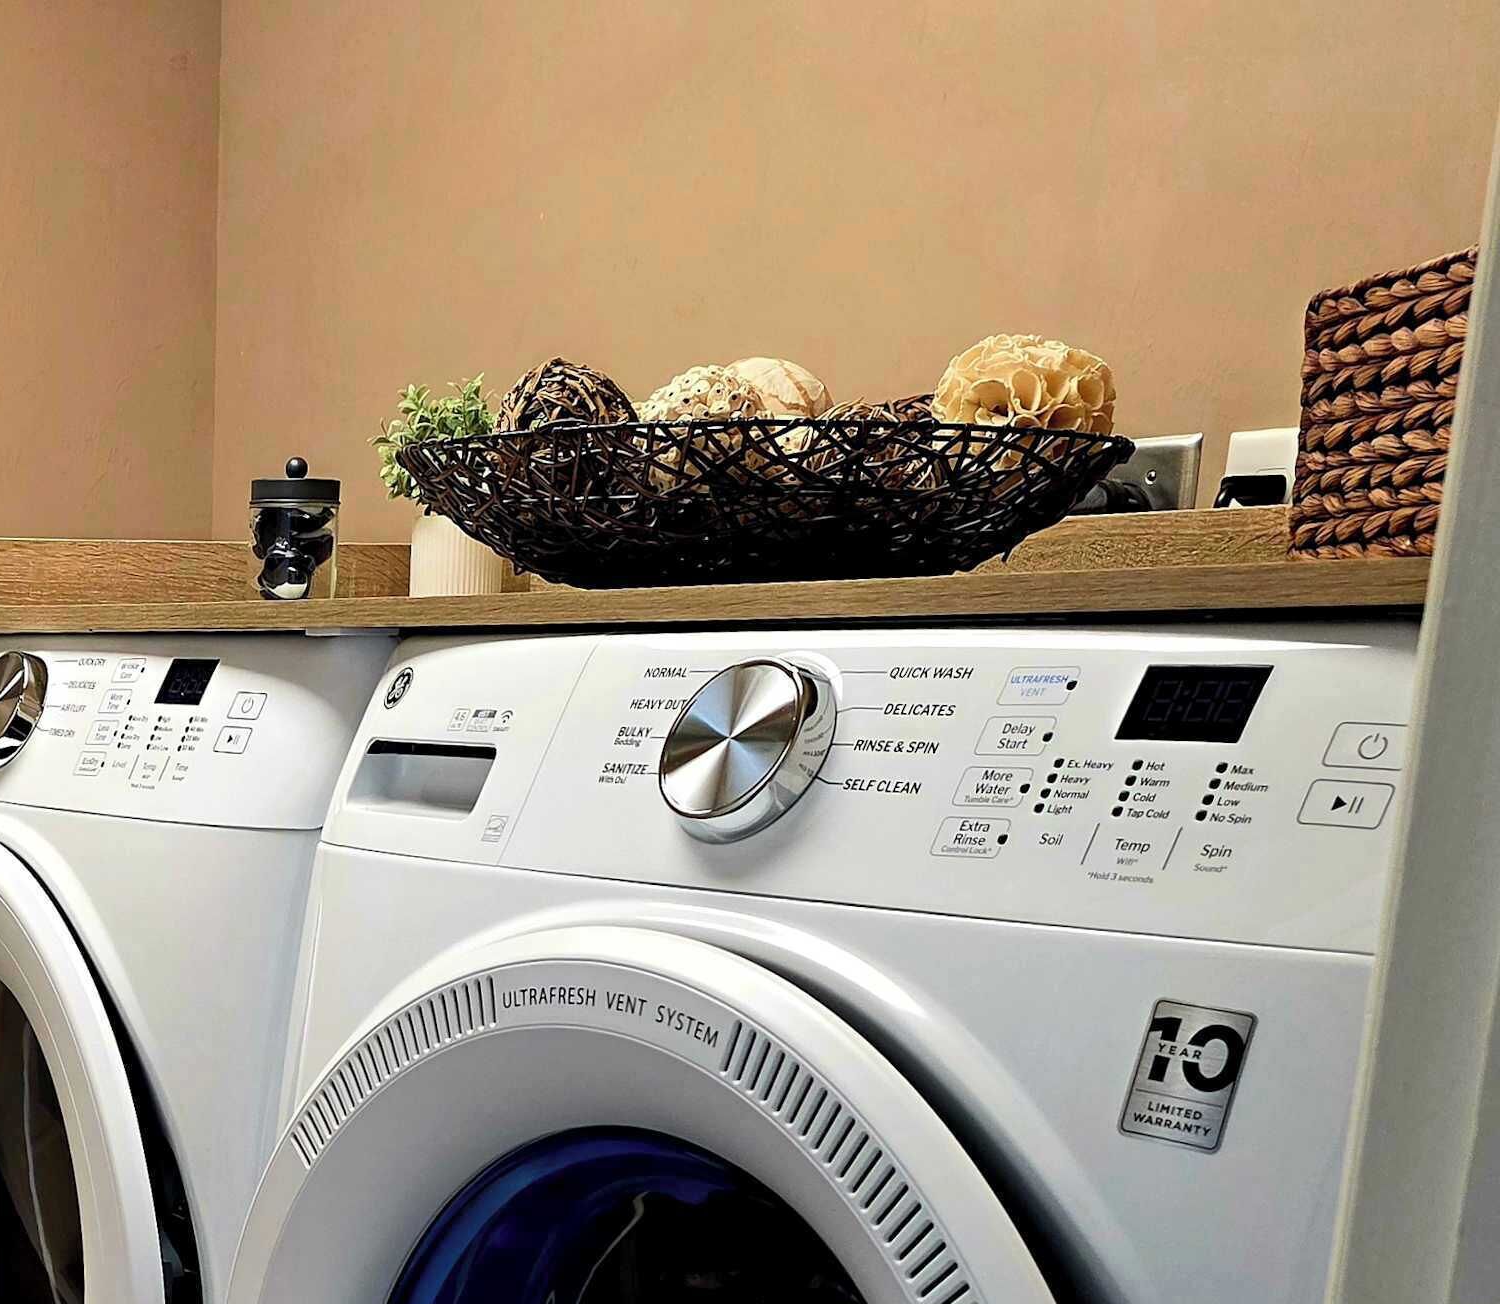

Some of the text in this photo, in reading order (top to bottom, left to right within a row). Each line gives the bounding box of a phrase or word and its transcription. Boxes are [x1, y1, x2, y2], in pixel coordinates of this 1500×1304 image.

[644, 668, 688, 678] NORMAL
[889, 667, 974, 680] QUICK WASH
[1010, 675, 1069, 684] ULTRAFRESH
[1020, 688, 1046, 697] VENT
[630, 699, 688, 710] HEAVY DUT
[883, 703, 956, 716] DELICATES
[618, 726, 652, 738] BULKY
[1002, 723, 1036, 736] Delay
[854, 739, 940, 754] RINSE & SPIN
[997, 738, 1028, 750] Start
[602, 762, 649, 774] SANITIZE
[1082, 760, 1114, 771] Heavy
[1146, 762, 1166, 772] Hot
[1230, 765, 1255, 776] Max
[981, 770, 1013, 782] More
[1060, 774, 1091, 784] Heavy
[842, 778, 922, 794] SELF CLEAN
[1140, 777, 1171, 788] Warm
[1223, 781, 1269, 793] Medium
[975, 783, 1011, 795] Water
[1053, 790, 1090, 800] Normal
[1132, 792, 1157, 802] Cold
[1217, 796, 1241, 807] Low
[1046, 804, 1073, 816] Light
[1126, 808, 1171, 820] Tap Cold
[1210, 812, 1252, 825] No Spin
[959, 820, 990, 833] Extra
[953, 833, 986, 846] Rinse
[1038, 832, 1064, 846] Soil
[1115, 838, 1151, 854] Temp
[1200, 844, 1233, 860] Spin
[1110, 873, 1118, 881] 3
[1118, 874, 1154, 884] seconds
[502, 986, 720, 1048] ULTRAFRESH VENT SYSTEM
[1148, 1016, 1247, 1093] 10
[1157, 1042, 1203, 1060] YEAR
[1147, 1101, 1203, 1121] LIMITED
[1133, 1112, 1213, 1137] WARRANTY
